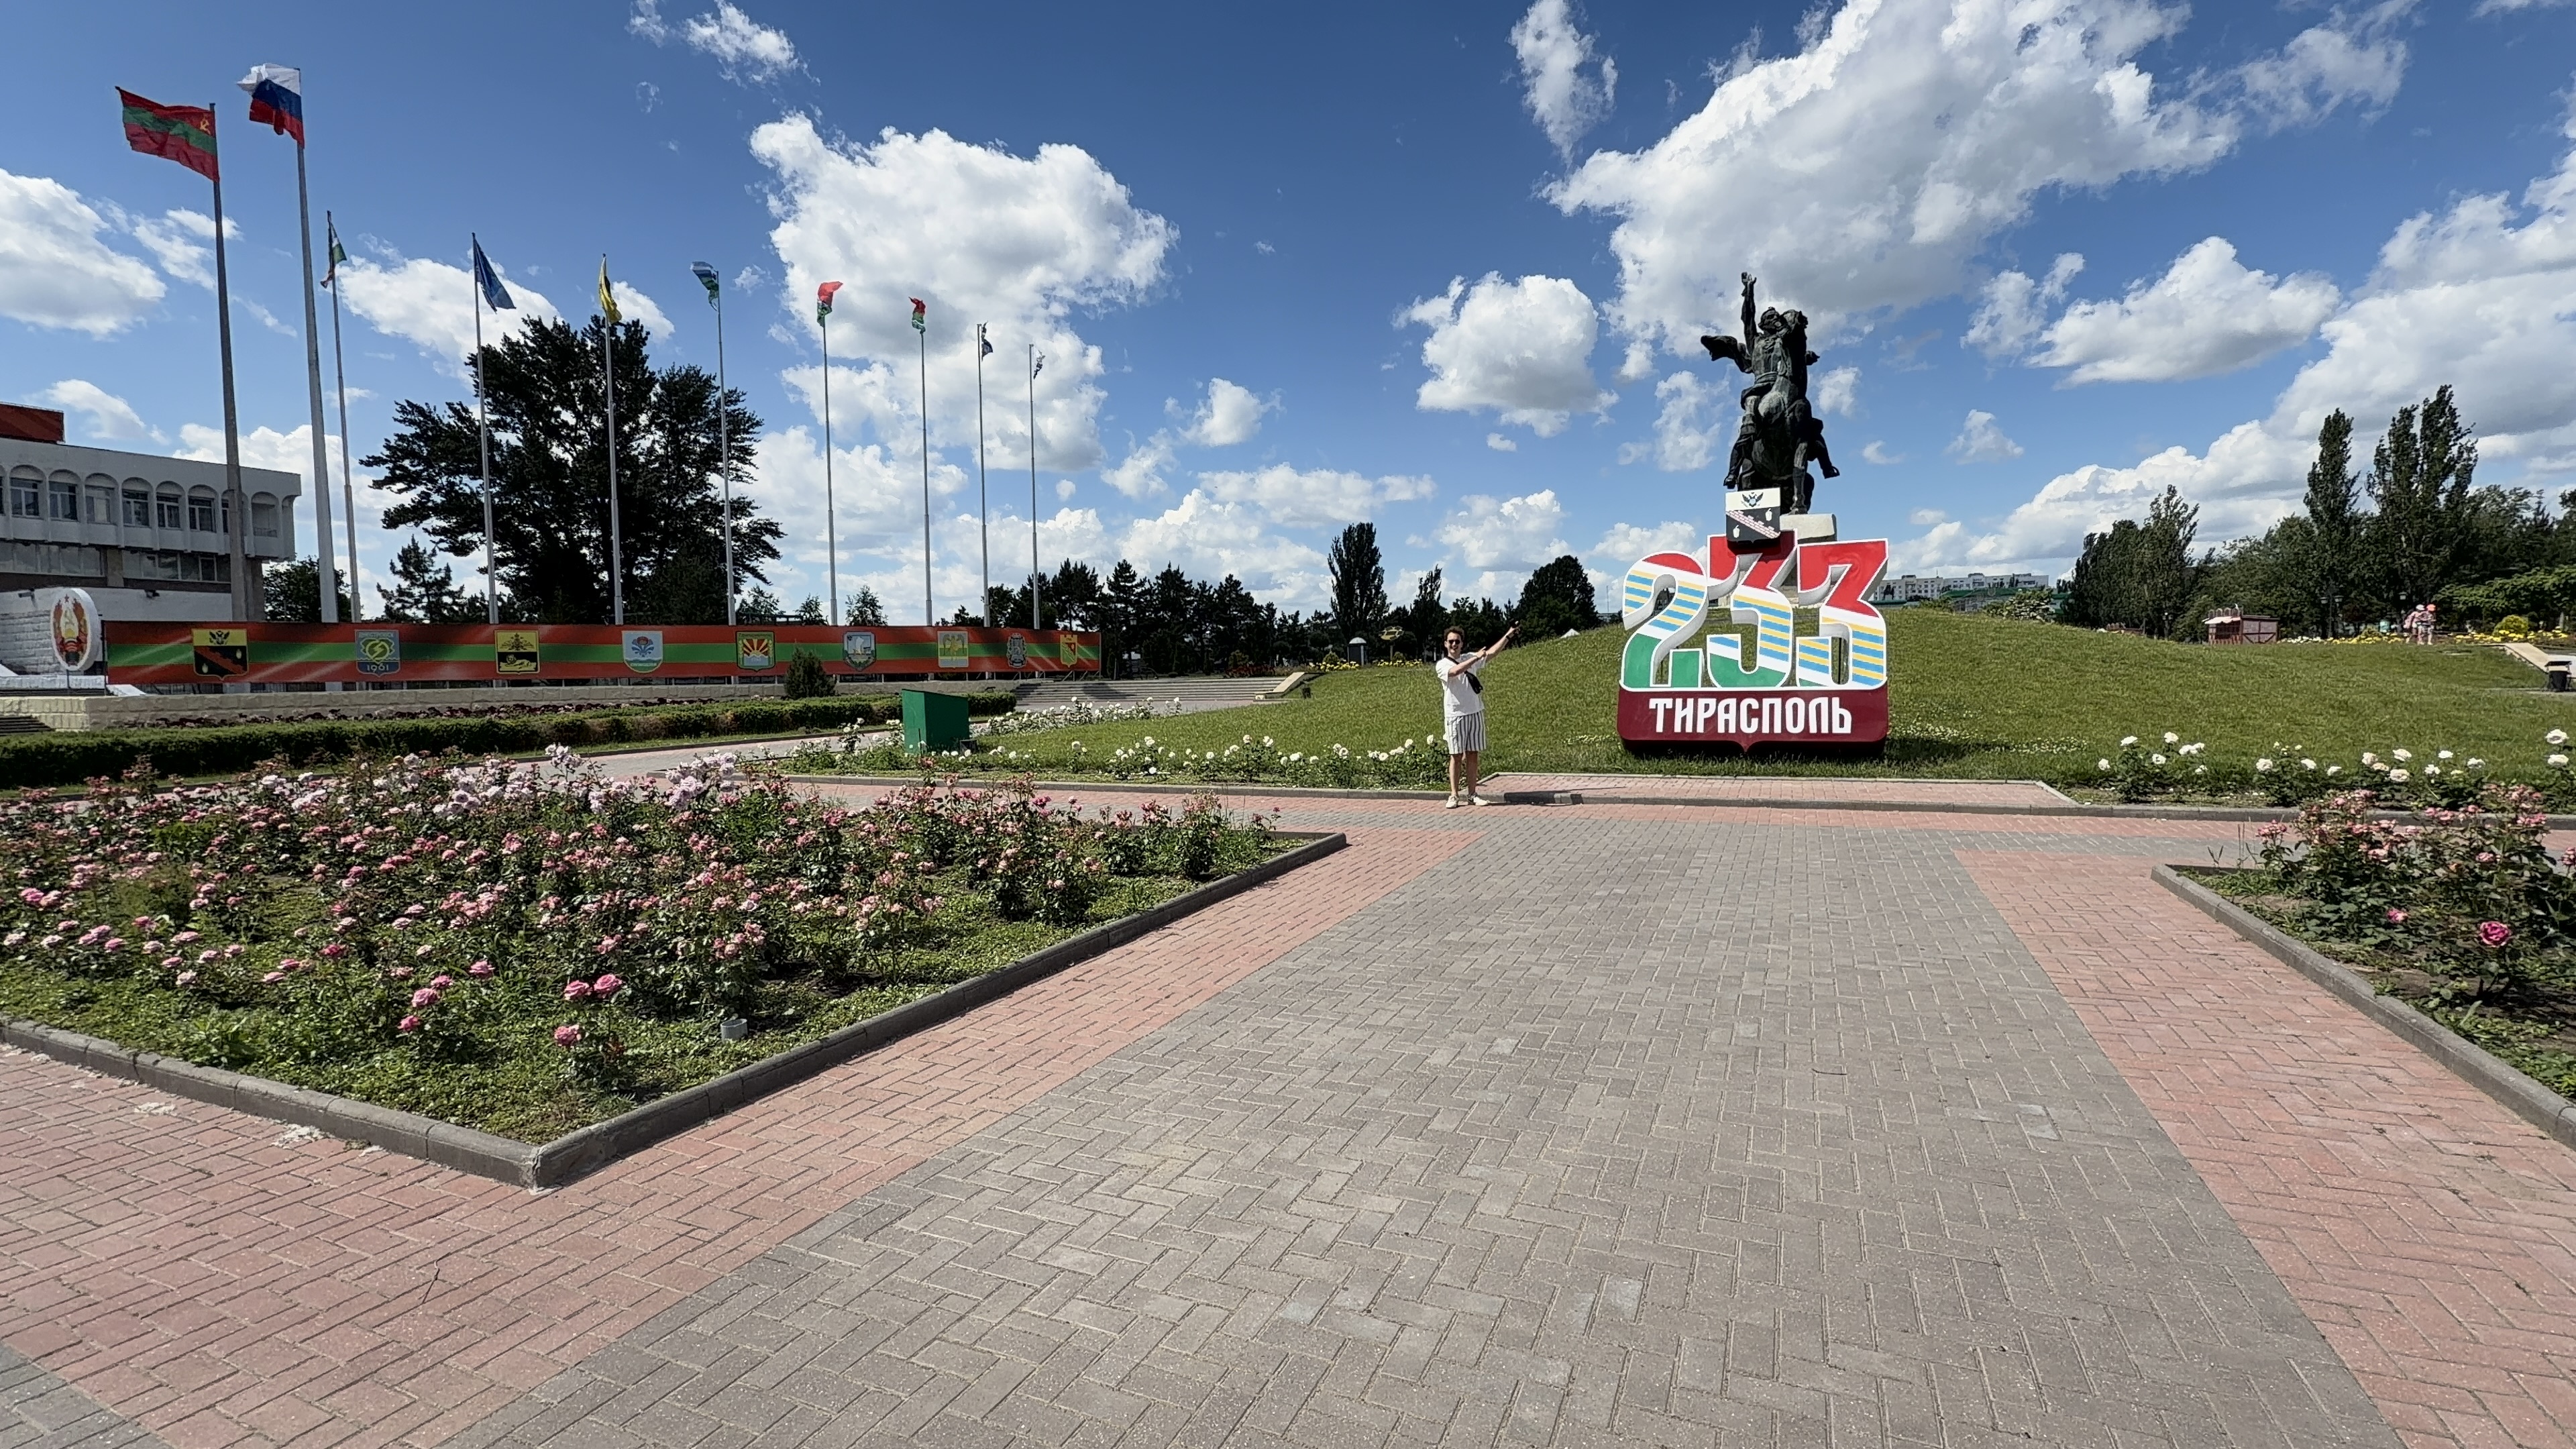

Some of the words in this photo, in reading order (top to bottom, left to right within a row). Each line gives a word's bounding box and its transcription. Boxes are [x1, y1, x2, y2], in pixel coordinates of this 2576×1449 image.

[1621, 529, 1889, 689] 233
[367, 663, 389, 673] 1961
[1648, 696, 1852, 734] ТИРАСПОЛЬ
